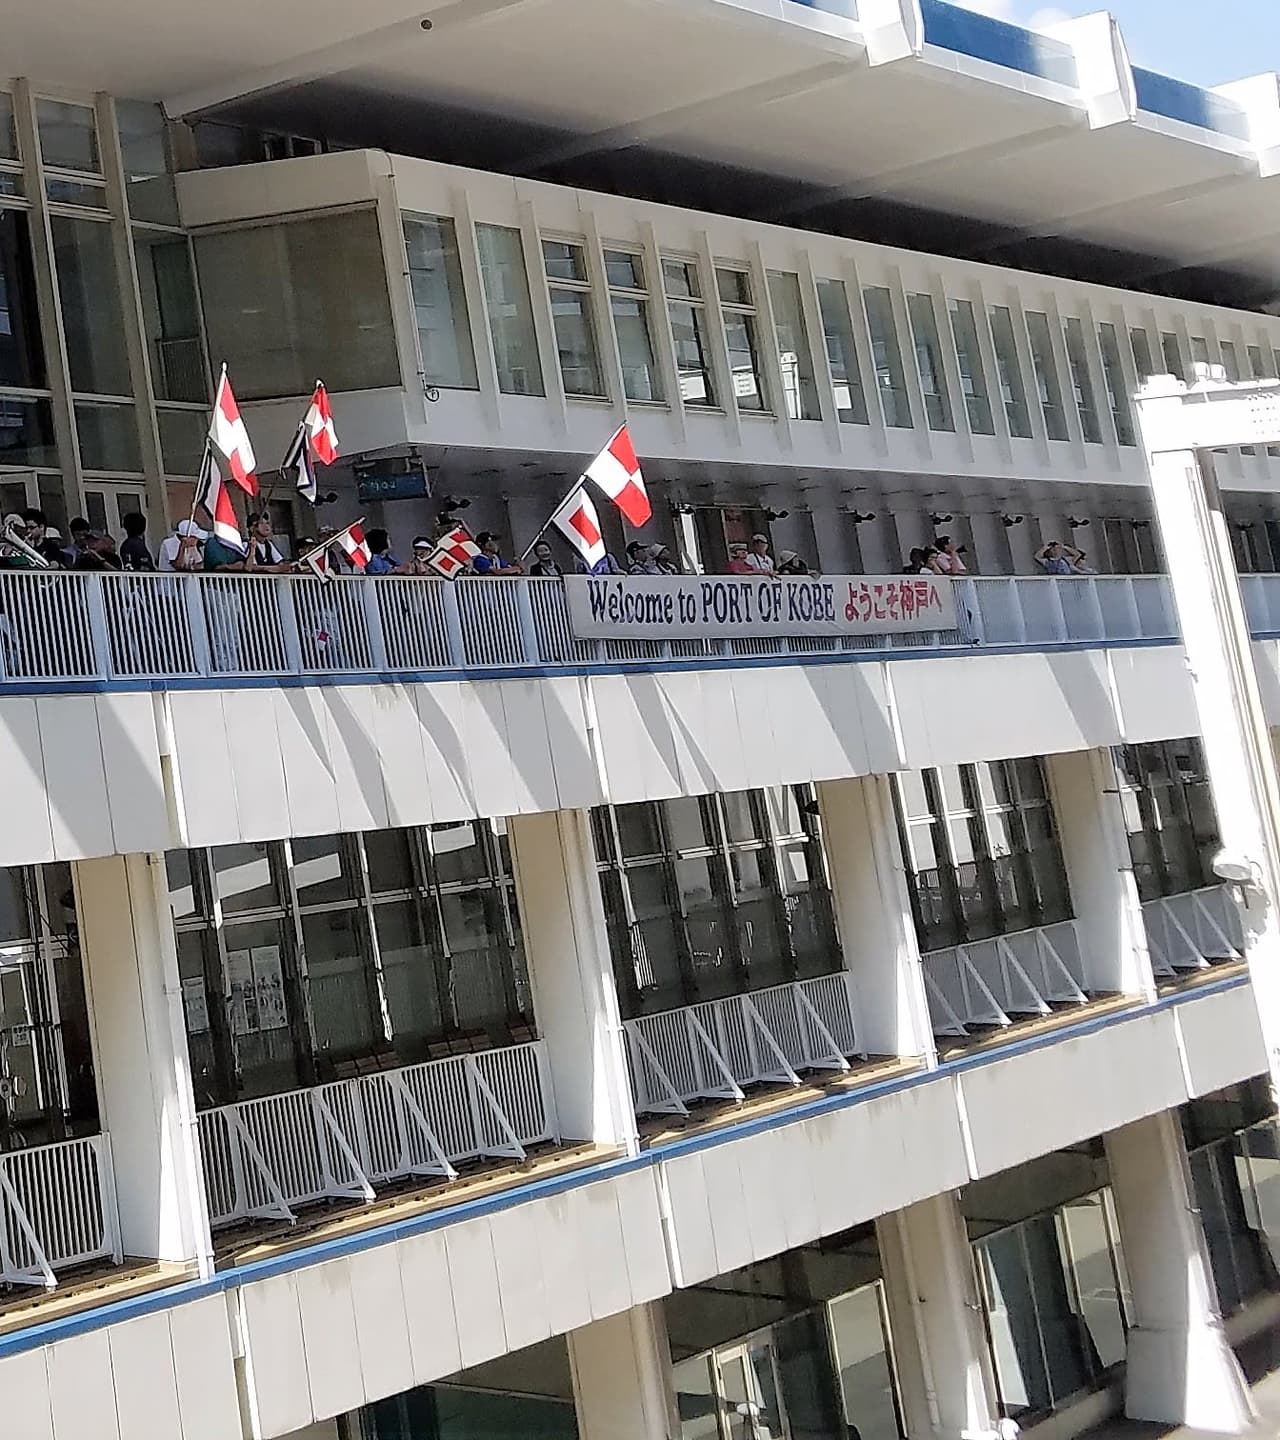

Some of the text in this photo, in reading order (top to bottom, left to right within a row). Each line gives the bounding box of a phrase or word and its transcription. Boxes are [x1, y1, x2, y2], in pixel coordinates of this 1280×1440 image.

[586, 579, 942, 624] Welcome to PORT OF KOBE ようこそ神戸へ
